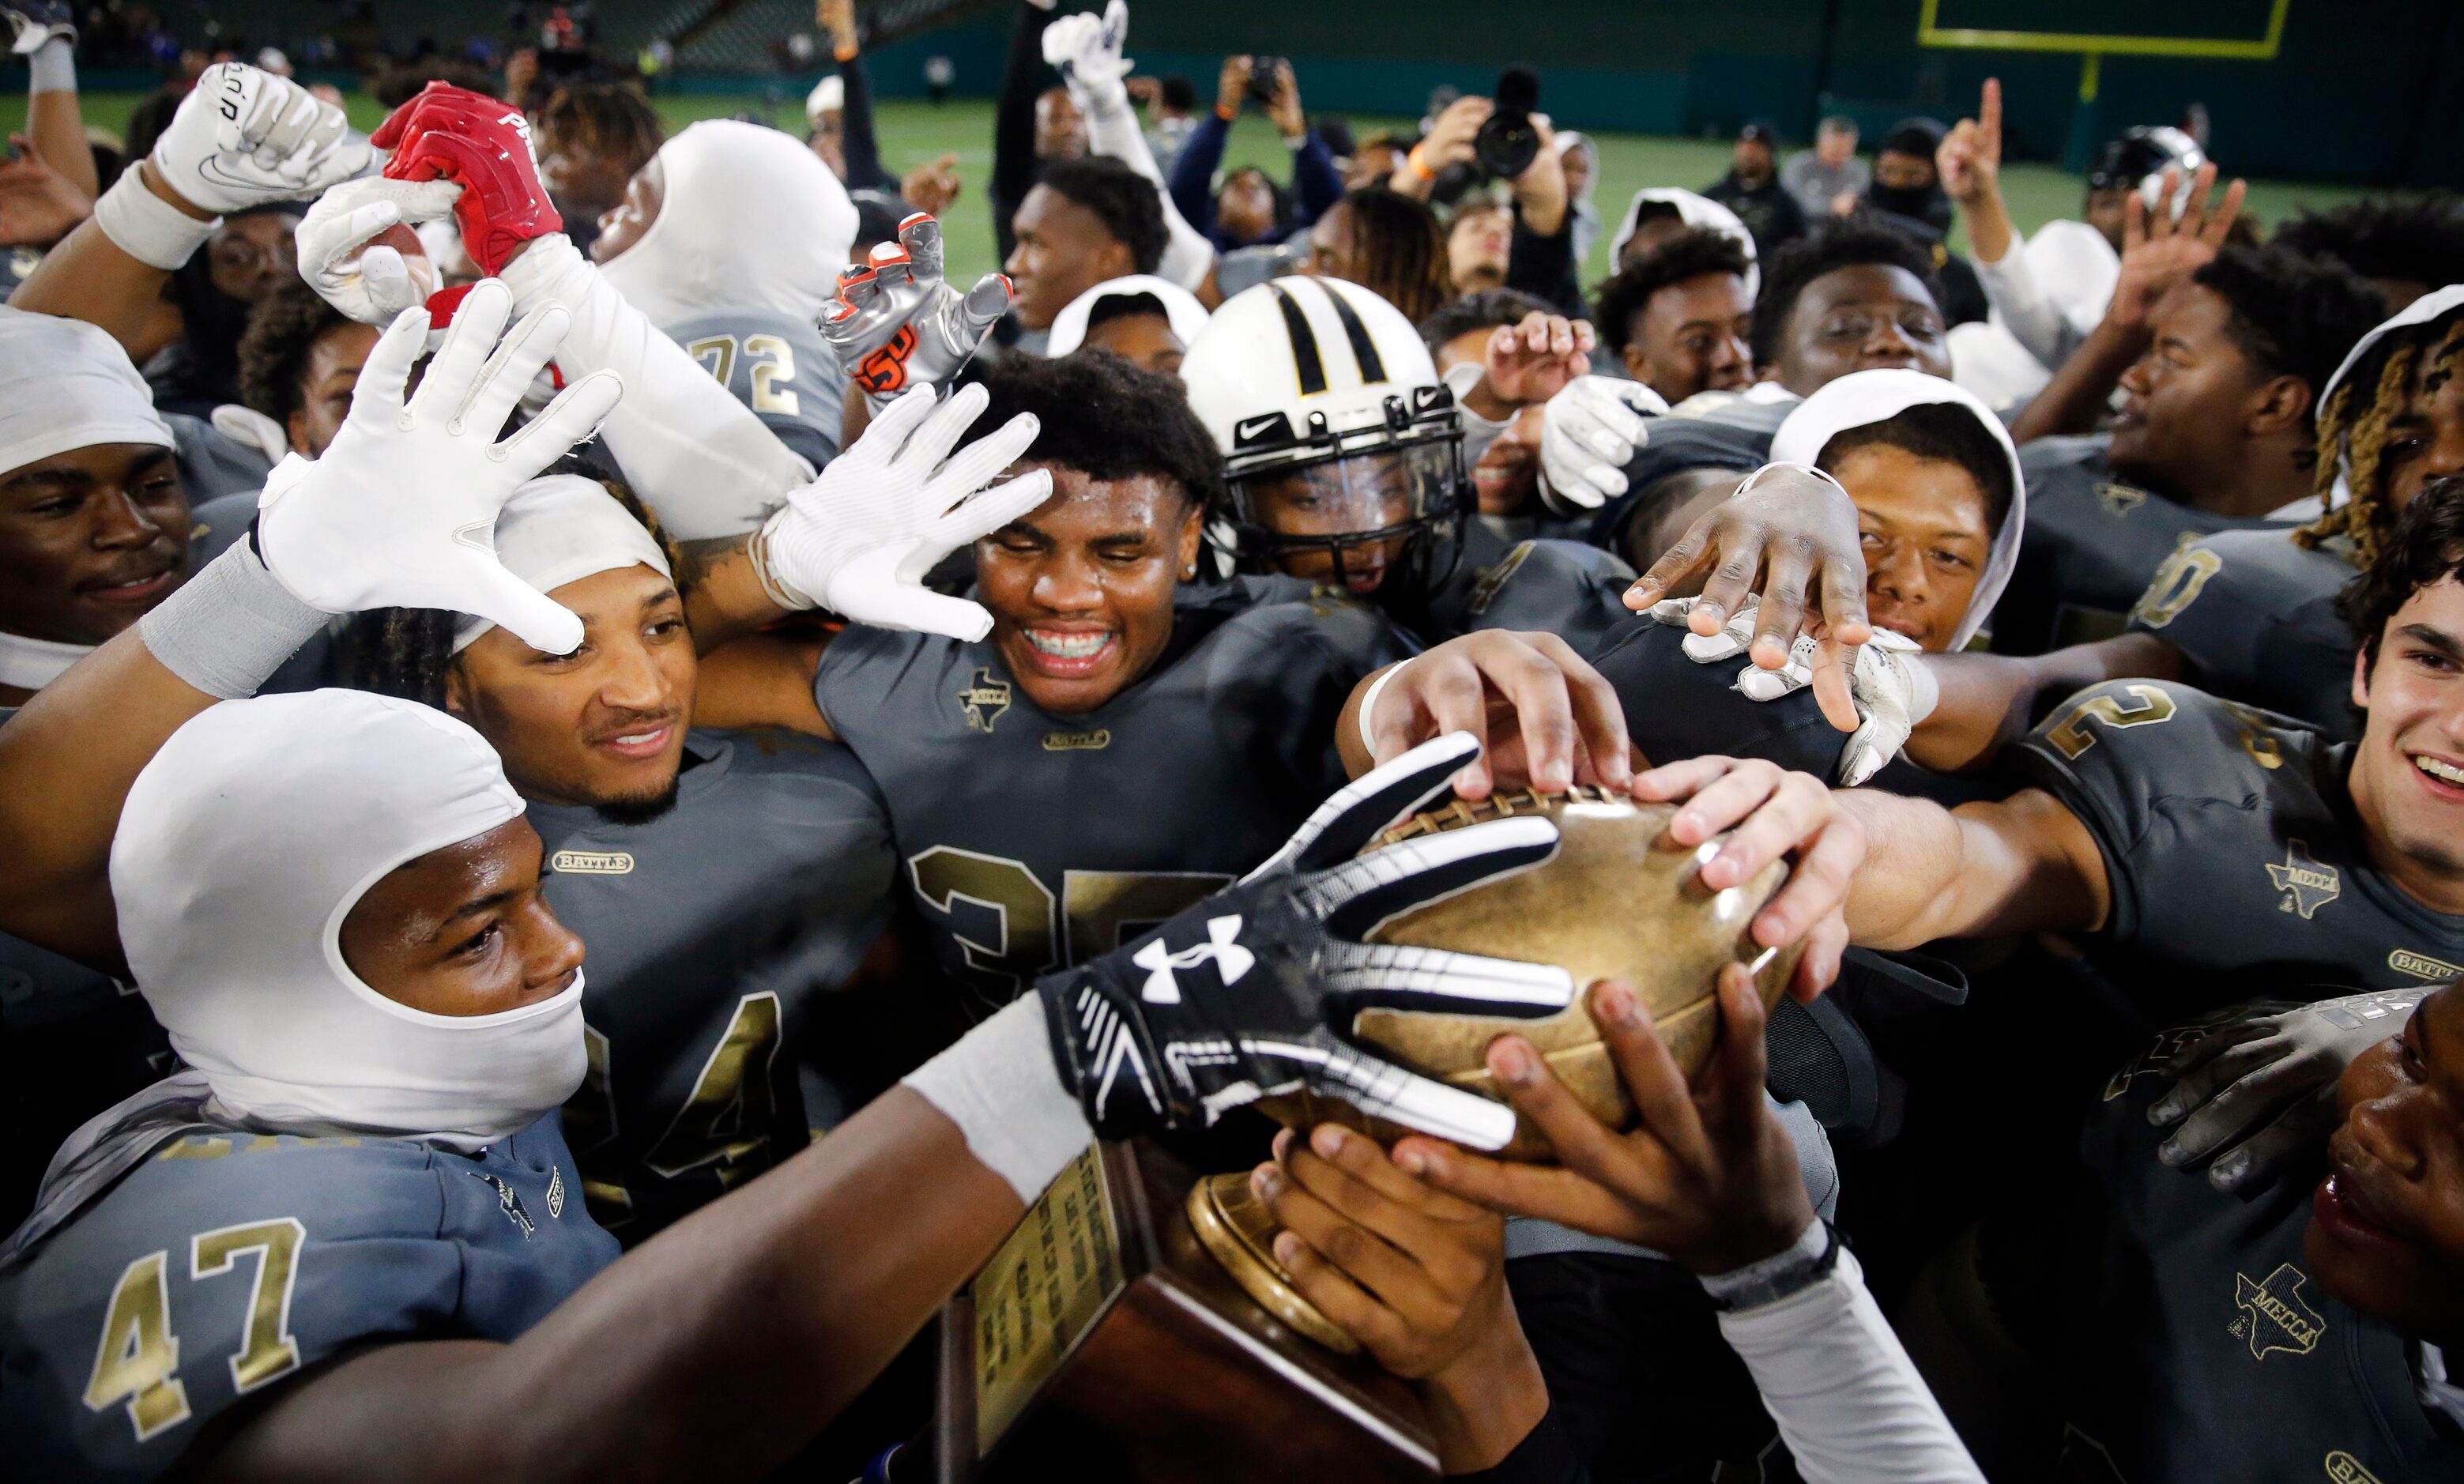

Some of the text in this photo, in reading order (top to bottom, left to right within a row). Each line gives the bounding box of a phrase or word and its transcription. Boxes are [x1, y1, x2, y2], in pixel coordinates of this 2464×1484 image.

[686, 333, 800, 416] 72
[558, 854, 627, 870] BATTLE
[2287, 867, 2338, 893] MECCA
[82, 1216, 307, 1442] 47
[2251, 1287, 2317, 1347] MECCA
